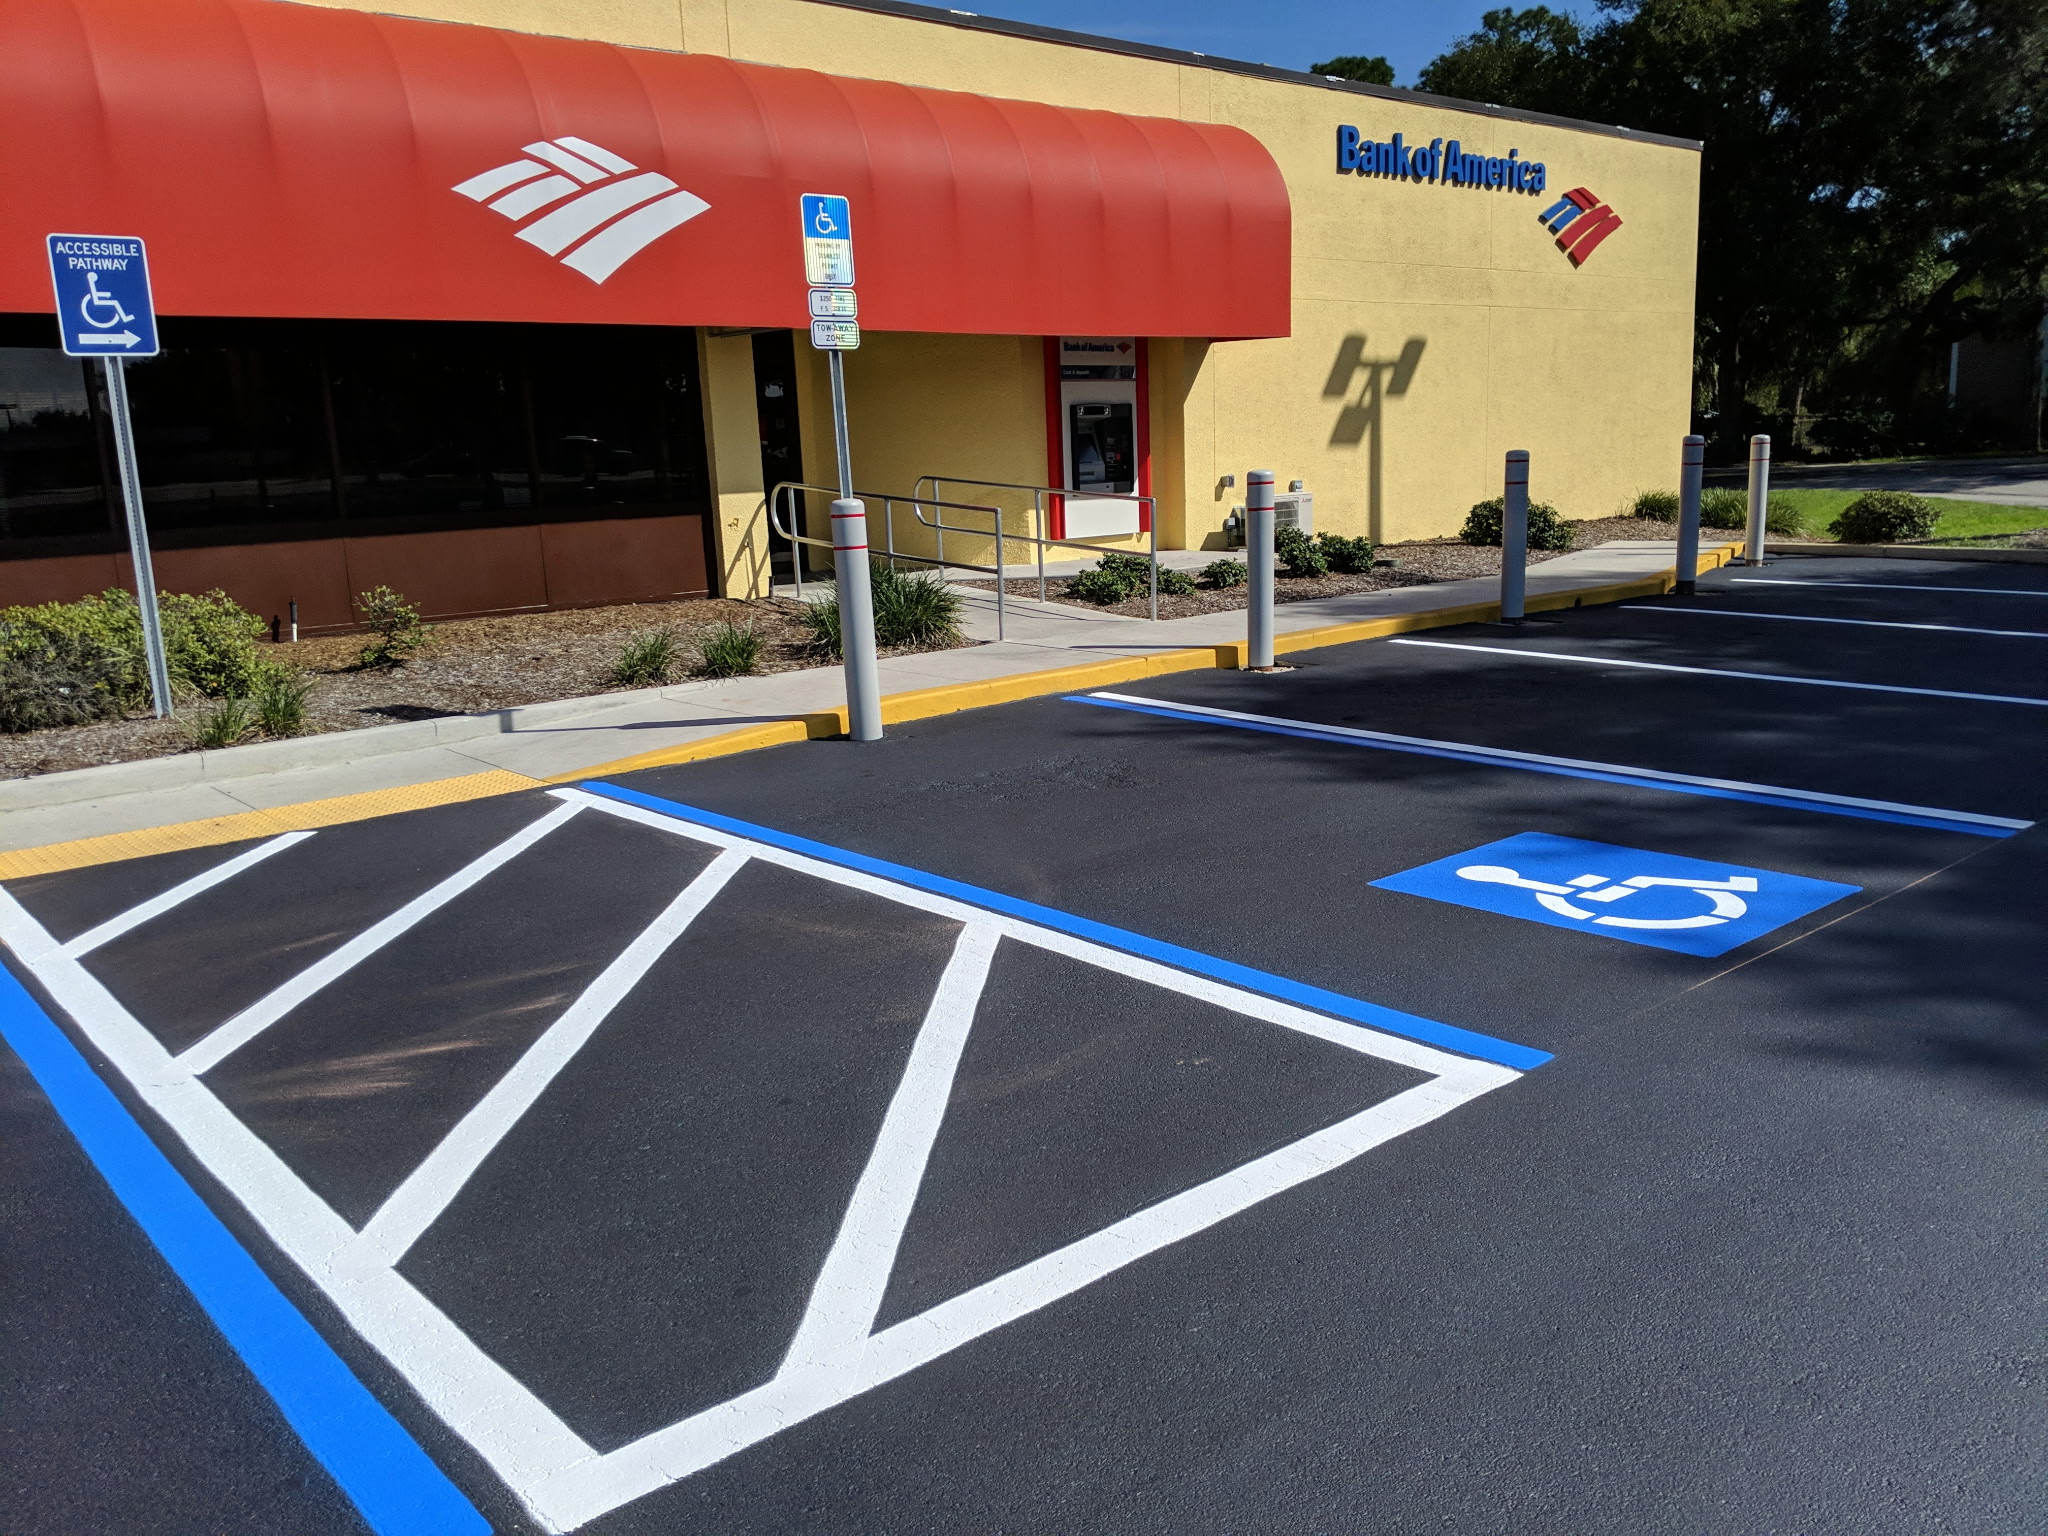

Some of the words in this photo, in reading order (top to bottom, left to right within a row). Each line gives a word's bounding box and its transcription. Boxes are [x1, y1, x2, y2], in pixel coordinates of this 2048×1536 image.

[1337, 124, 1413, 177] Bank
[1411, 137, 1443, 180] of
[1444, 139, 1546, 191] America
[56, 241, 139, 256] ACCESSIBLE
[68, 257, 128, 270] PATHWAY
[816, 324, 854, 332] TOW-AWAY
[826, 334, 845, 342] ZONE
